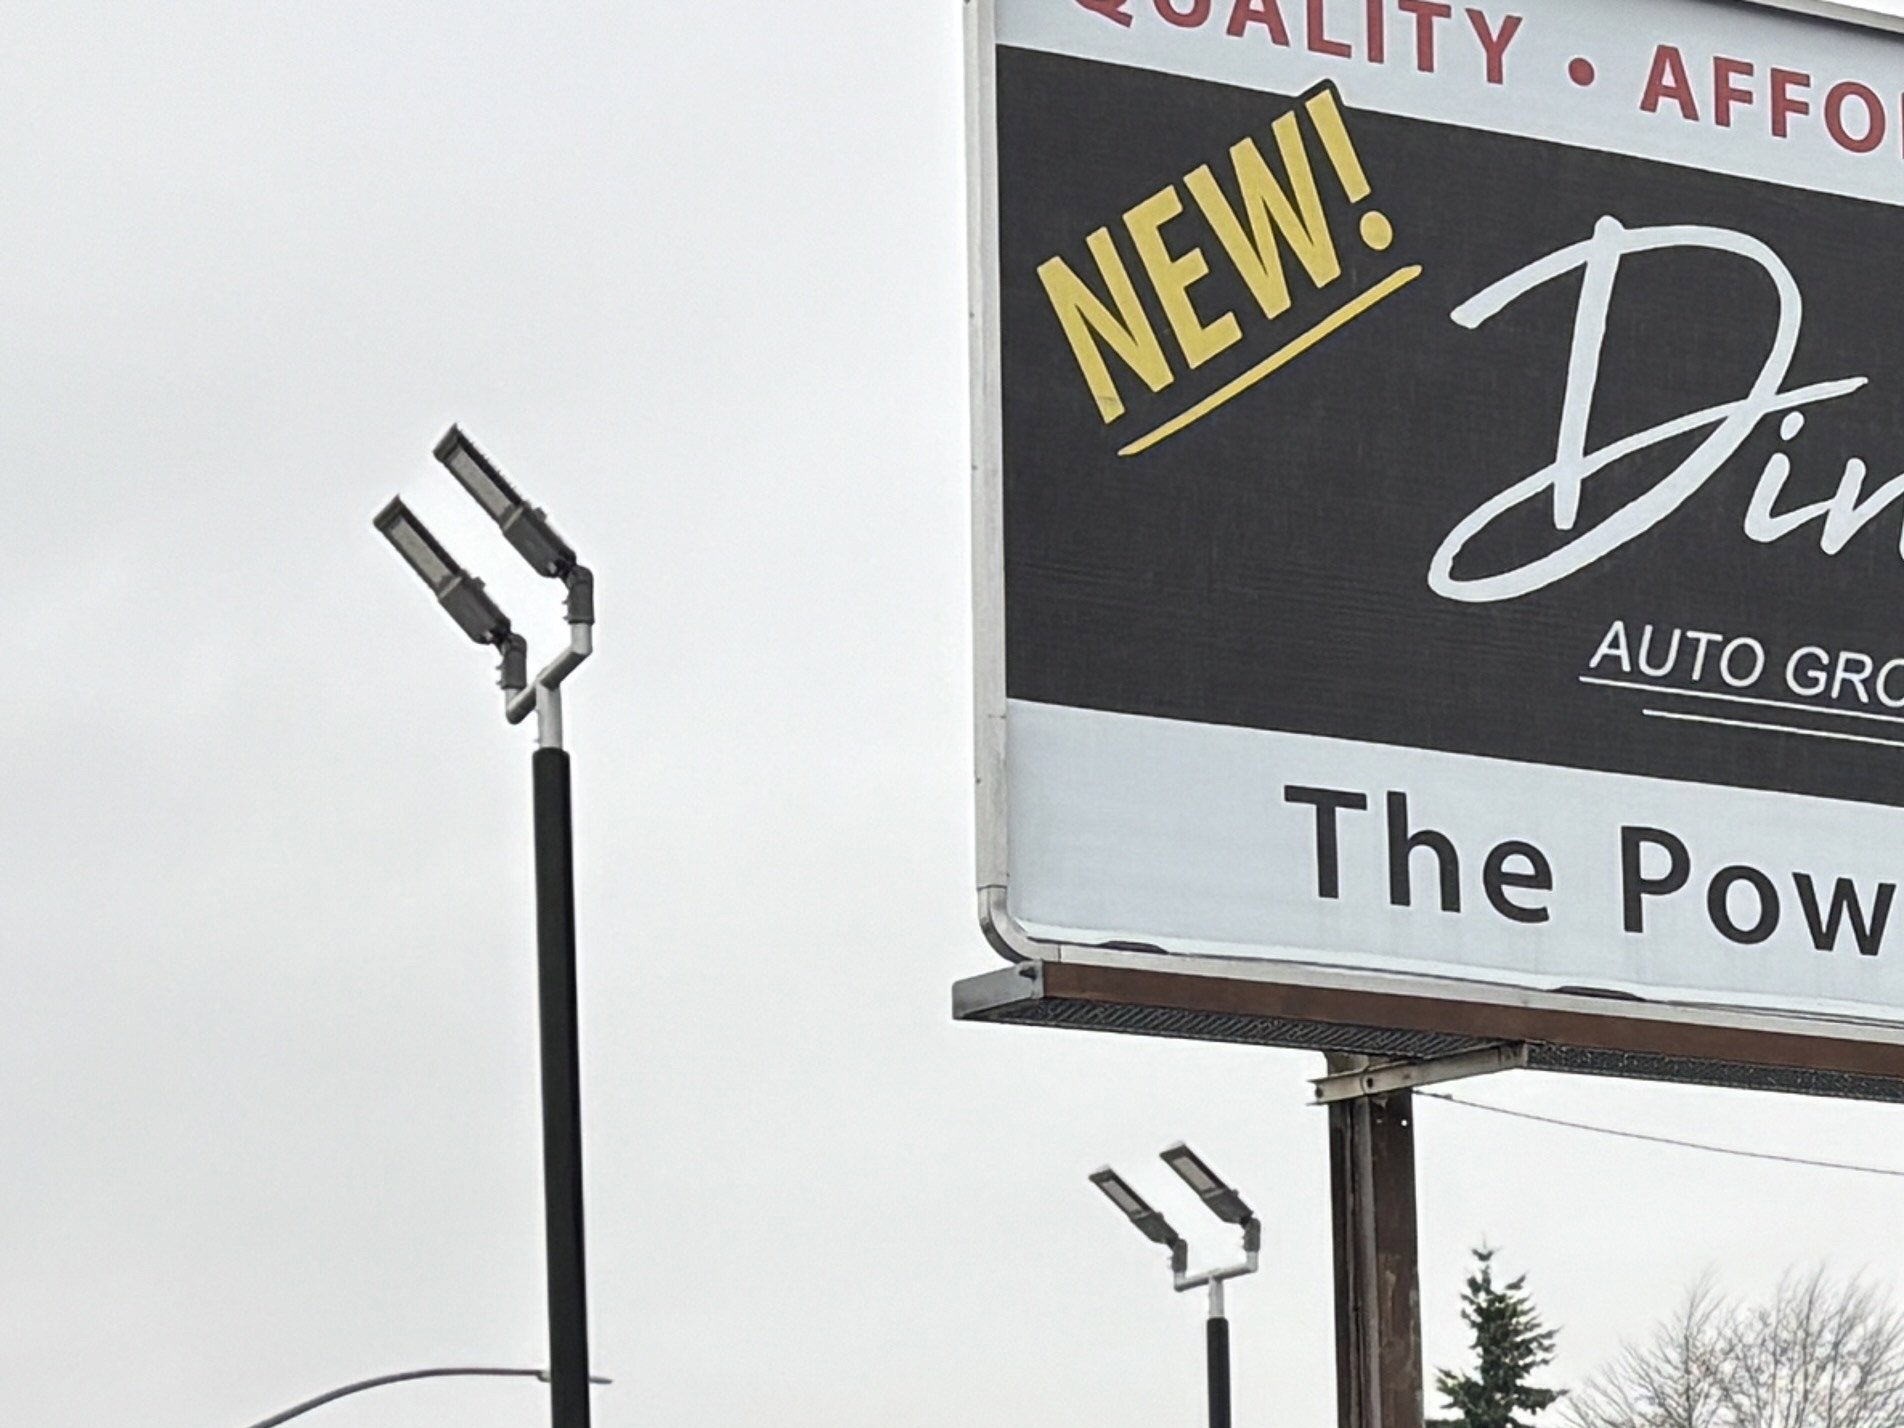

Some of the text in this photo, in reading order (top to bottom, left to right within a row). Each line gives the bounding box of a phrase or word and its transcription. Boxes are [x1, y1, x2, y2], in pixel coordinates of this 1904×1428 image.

[1078, 0, 1524, 85] ALITY
[1037, 90, 1394, 424] NEW!
[1588, 620, 1766, 688] AUTO
[1283, 783, 1554, 925] The
